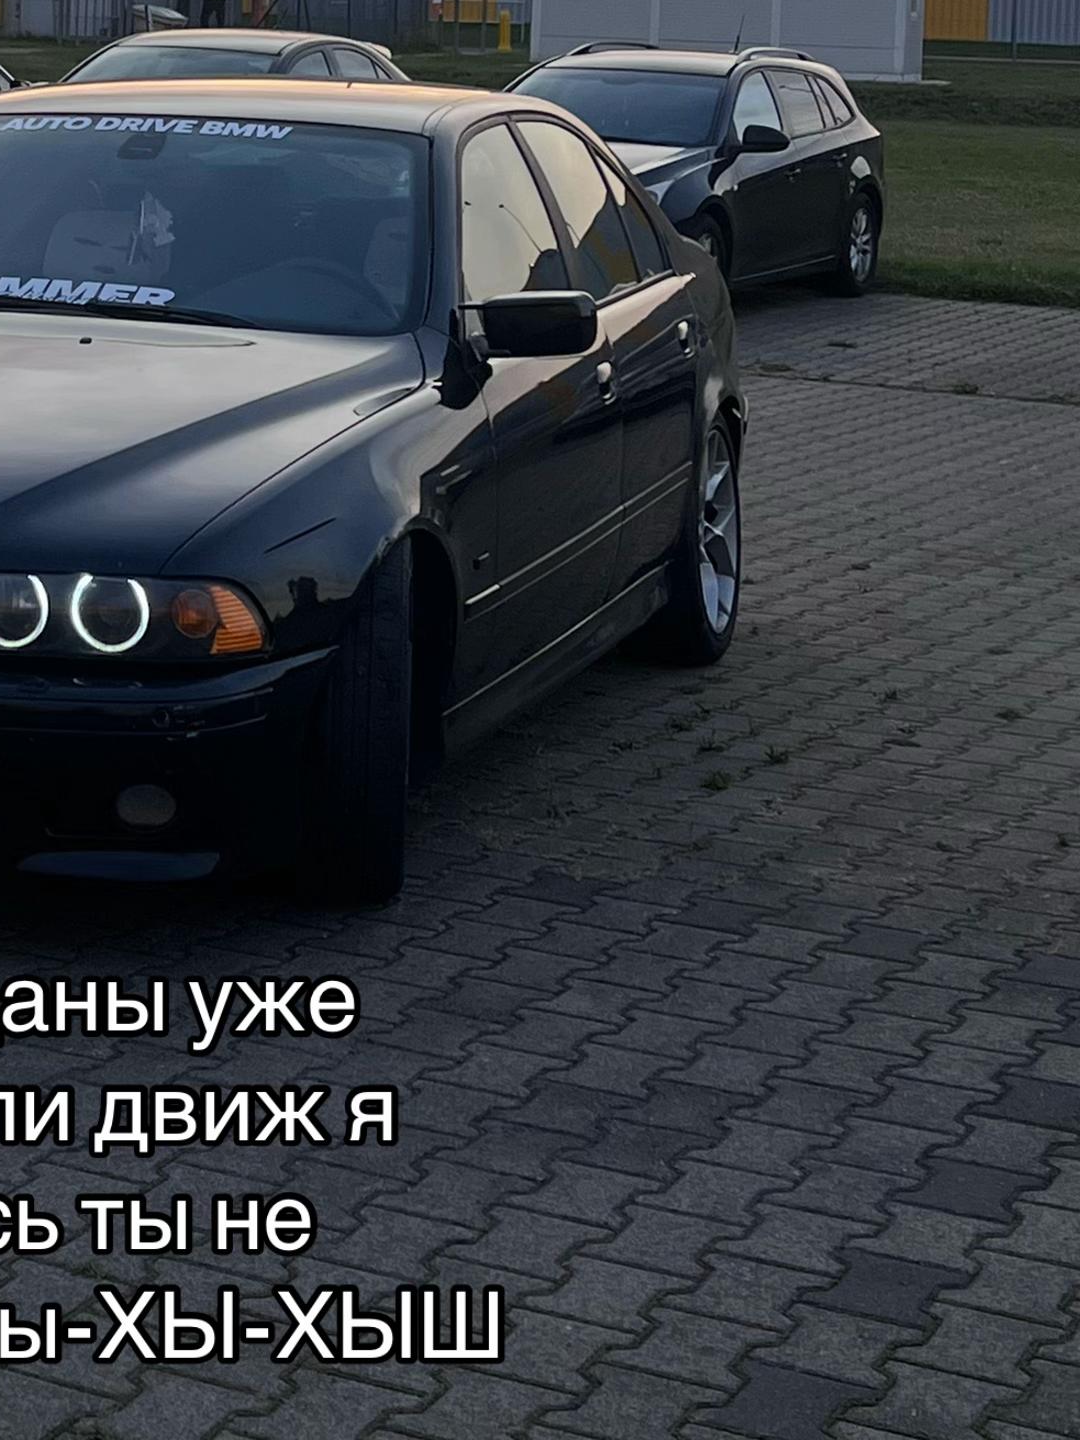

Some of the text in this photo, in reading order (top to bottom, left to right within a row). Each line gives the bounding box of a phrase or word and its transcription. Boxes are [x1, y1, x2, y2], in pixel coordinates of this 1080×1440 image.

[0, 116, 293, 140] AUTO DRIVE BMW
